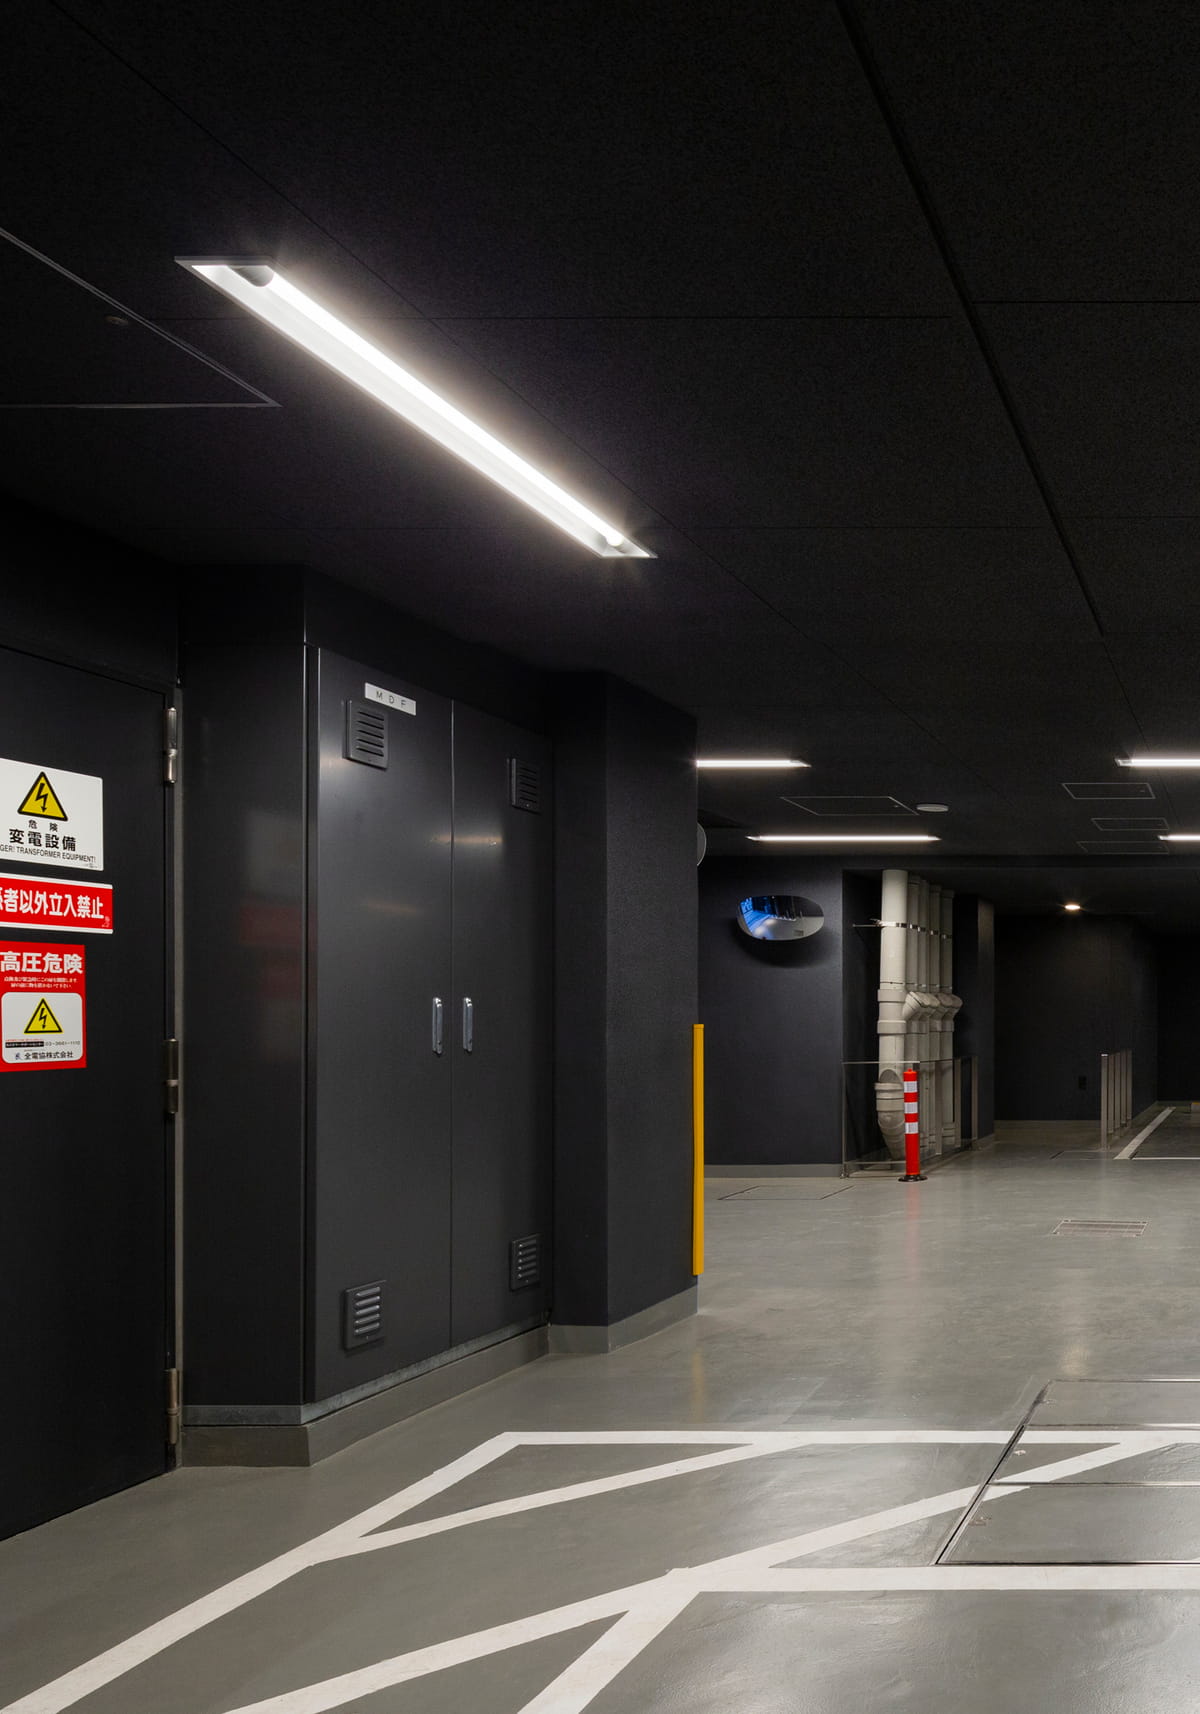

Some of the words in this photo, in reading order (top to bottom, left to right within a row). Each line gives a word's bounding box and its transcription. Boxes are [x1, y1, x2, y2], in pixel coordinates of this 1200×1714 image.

[28, 820, 58, 832] 危険
[9, 828, 76, 852] 変電設備
[16, 847, 61, 859] TRANSFORMER
[62, 852, 96, 863] EQUIPMENT!
[0, 951, 83, 974] 高圧危険
